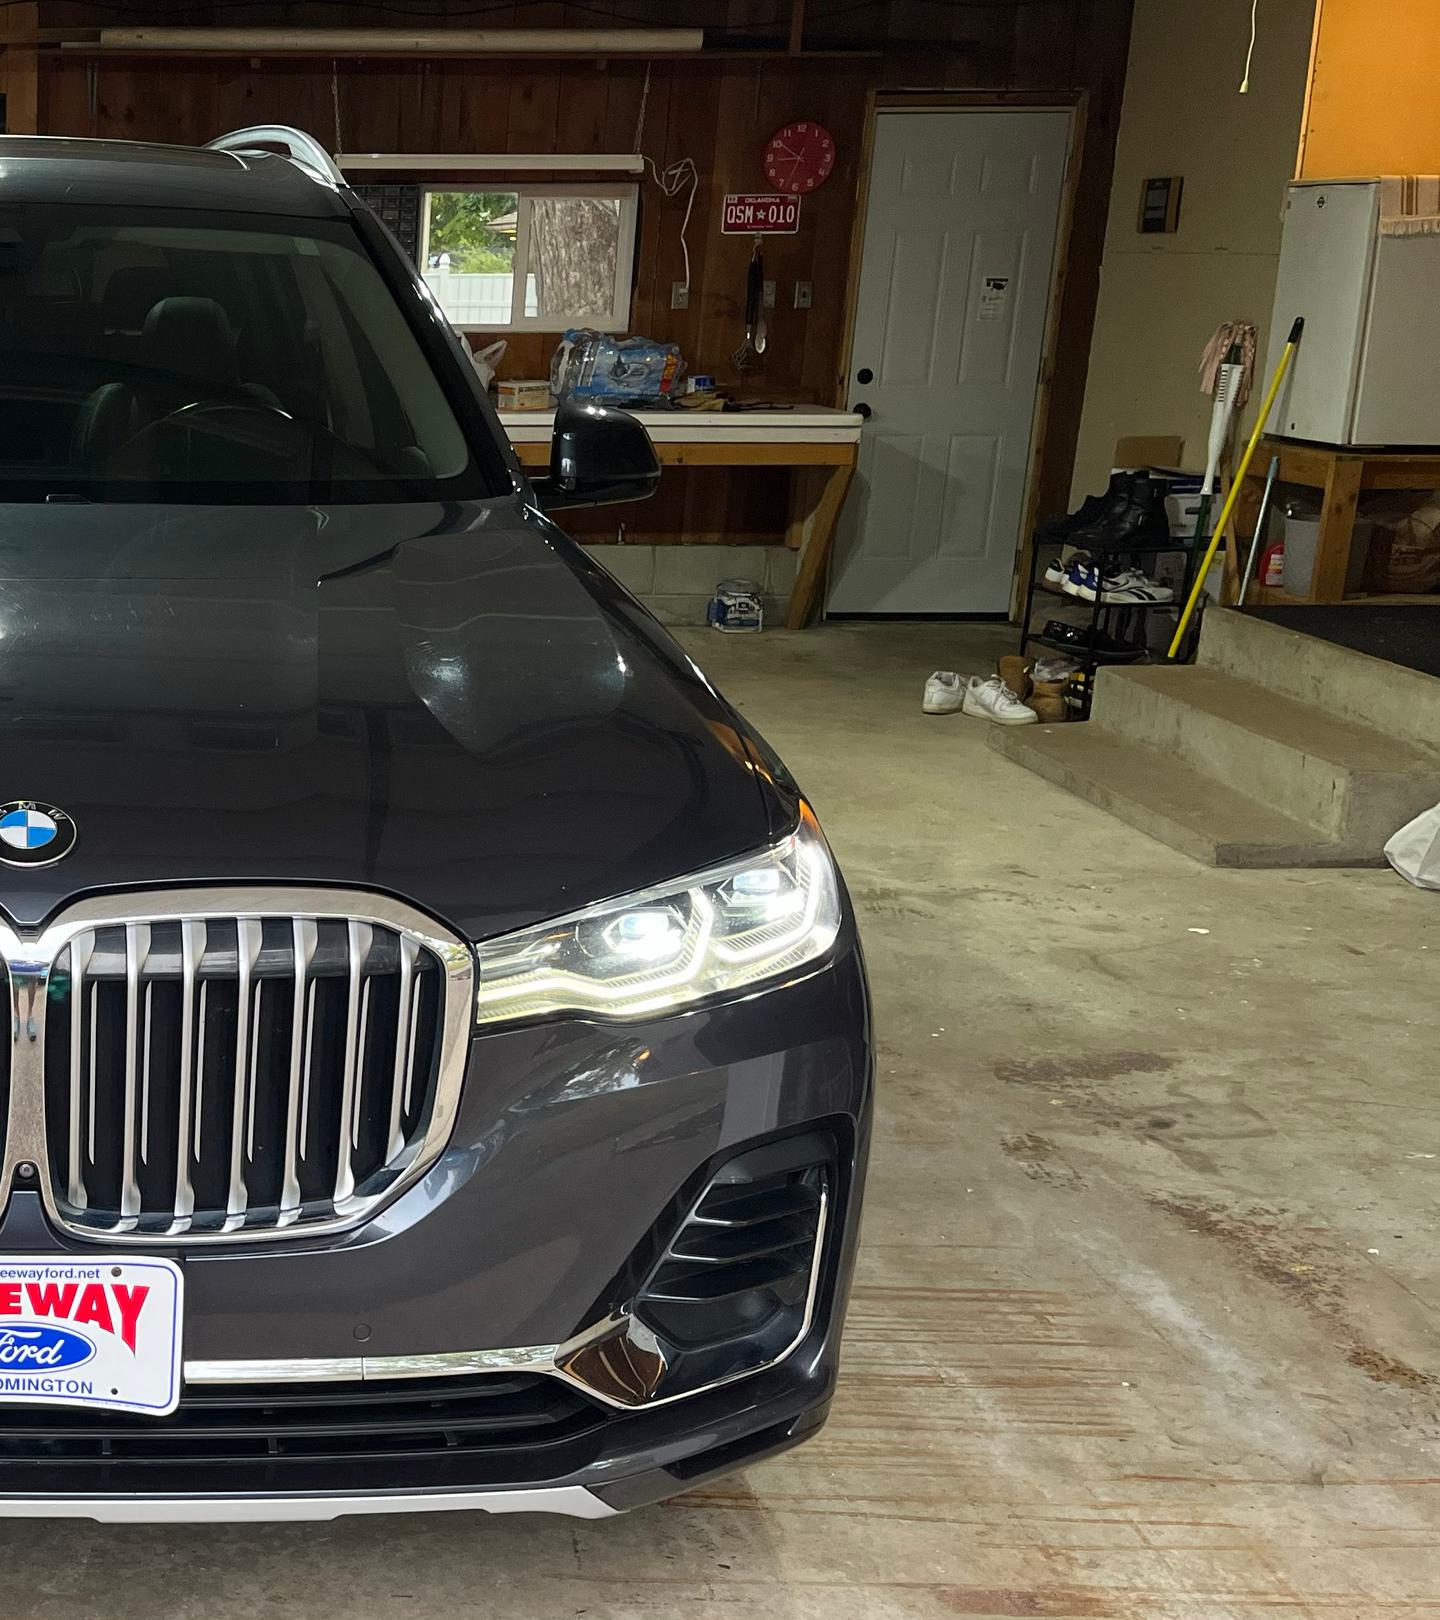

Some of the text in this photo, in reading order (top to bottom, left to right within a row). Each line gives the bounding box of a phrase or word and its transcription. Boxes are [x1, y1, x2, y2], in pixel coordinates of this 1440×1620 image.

[797, 124, 807, 133] 12
[783, 129, 792, 138] 11
[772, 140, 782, 149] 10
[822, 139, 829, 148] 2
[766, 153, 774, 163] 9
[824, 154, 832, 162] 3
[768, 167, 776, 177] 8
[818, 167, 825, 177] 4
[779, 178, 785, 187] 7
[791, 182, 799, 192] 6
[807, 178, 814, 187] 5
[727, 205, 795, 224] QSM 010
